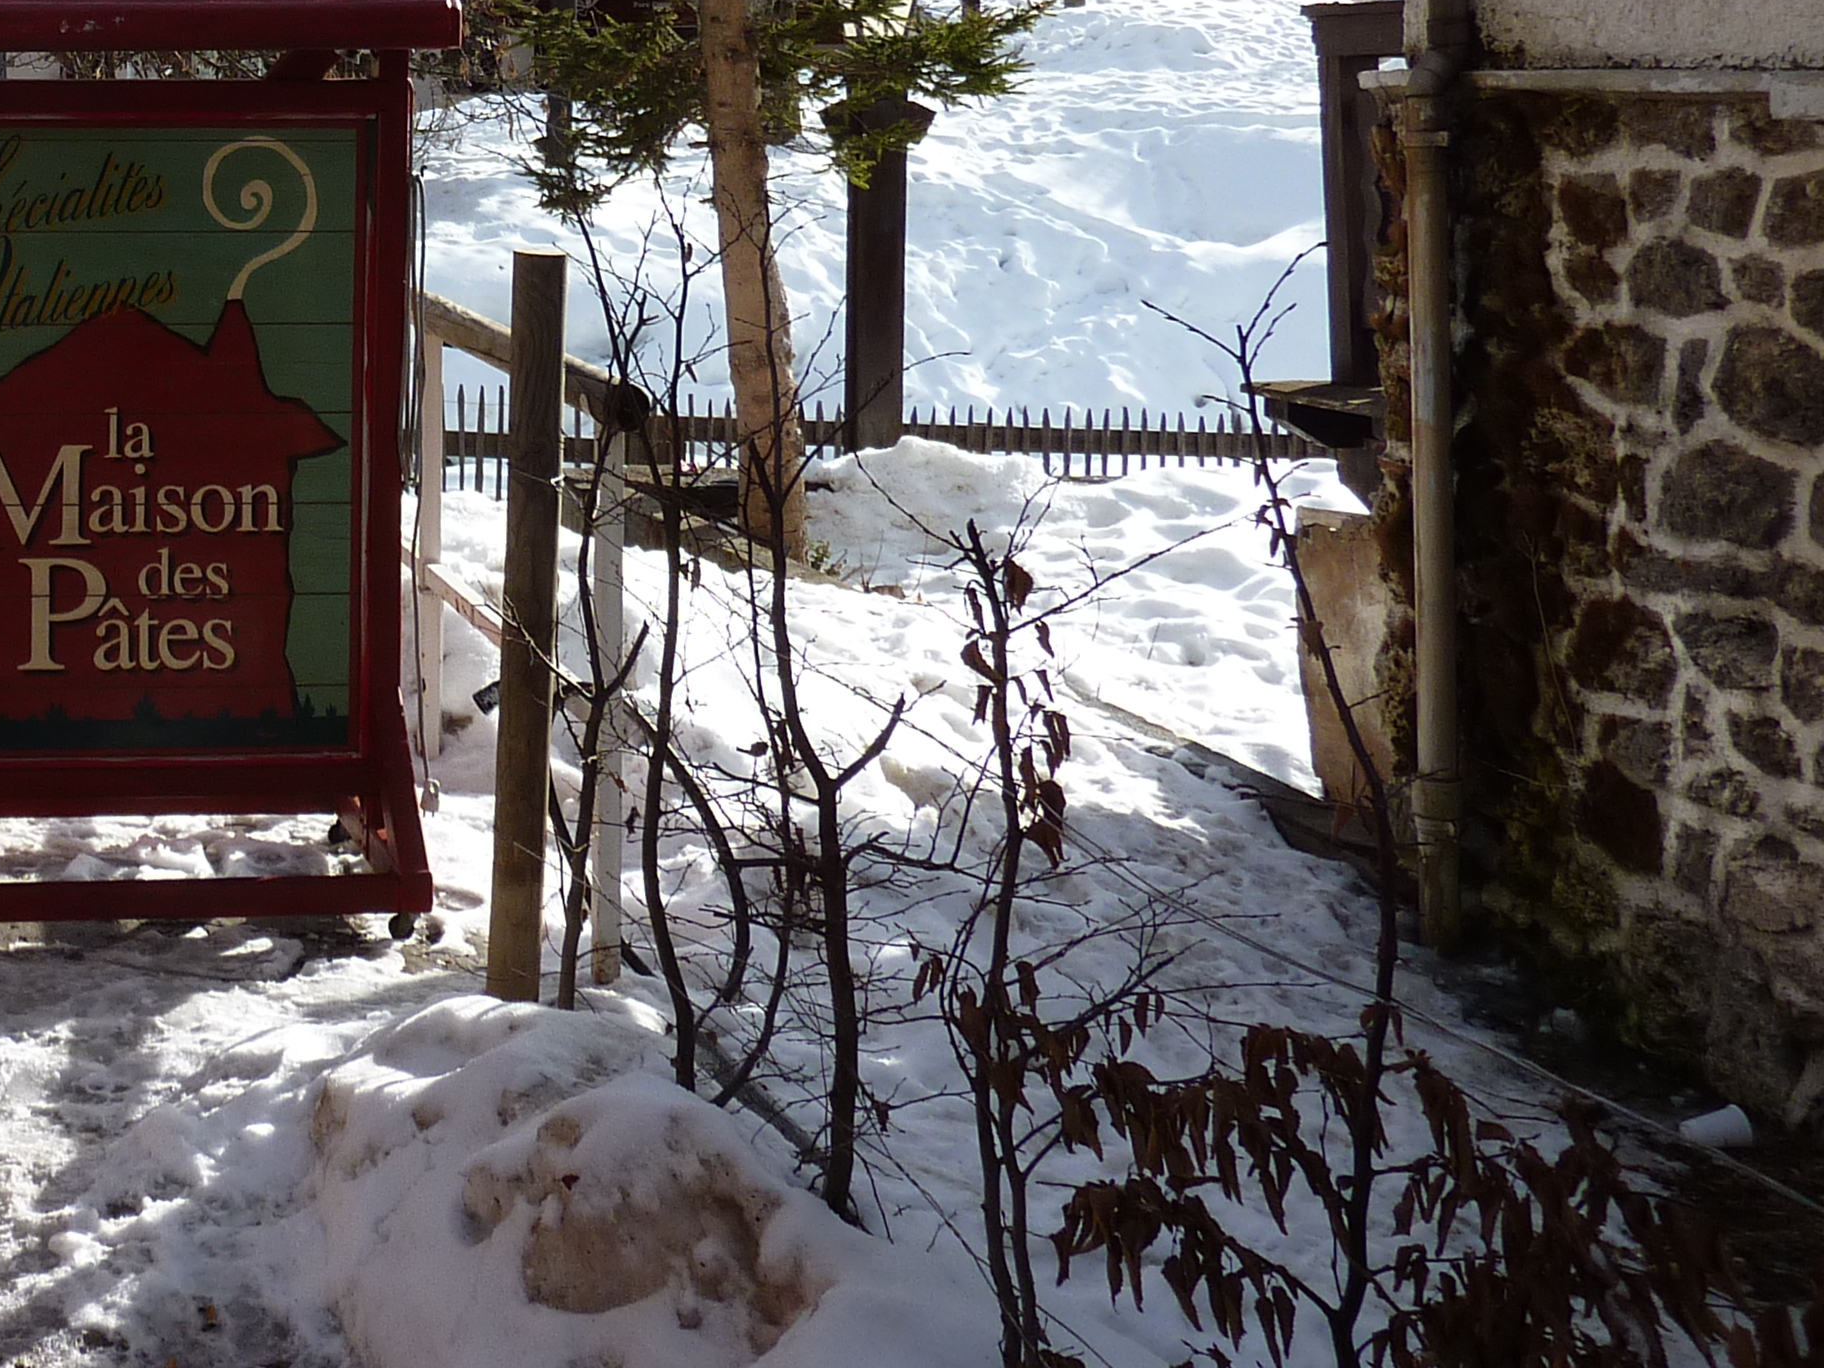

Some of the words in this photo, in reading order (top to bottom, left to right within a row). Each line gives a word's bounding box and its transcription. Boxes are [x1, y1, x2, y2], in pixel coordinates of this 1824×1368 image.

[104, 406, 155, 459] la
[137, 547, 229, 599] des
[16, 556, 236, 671] Pâtes
